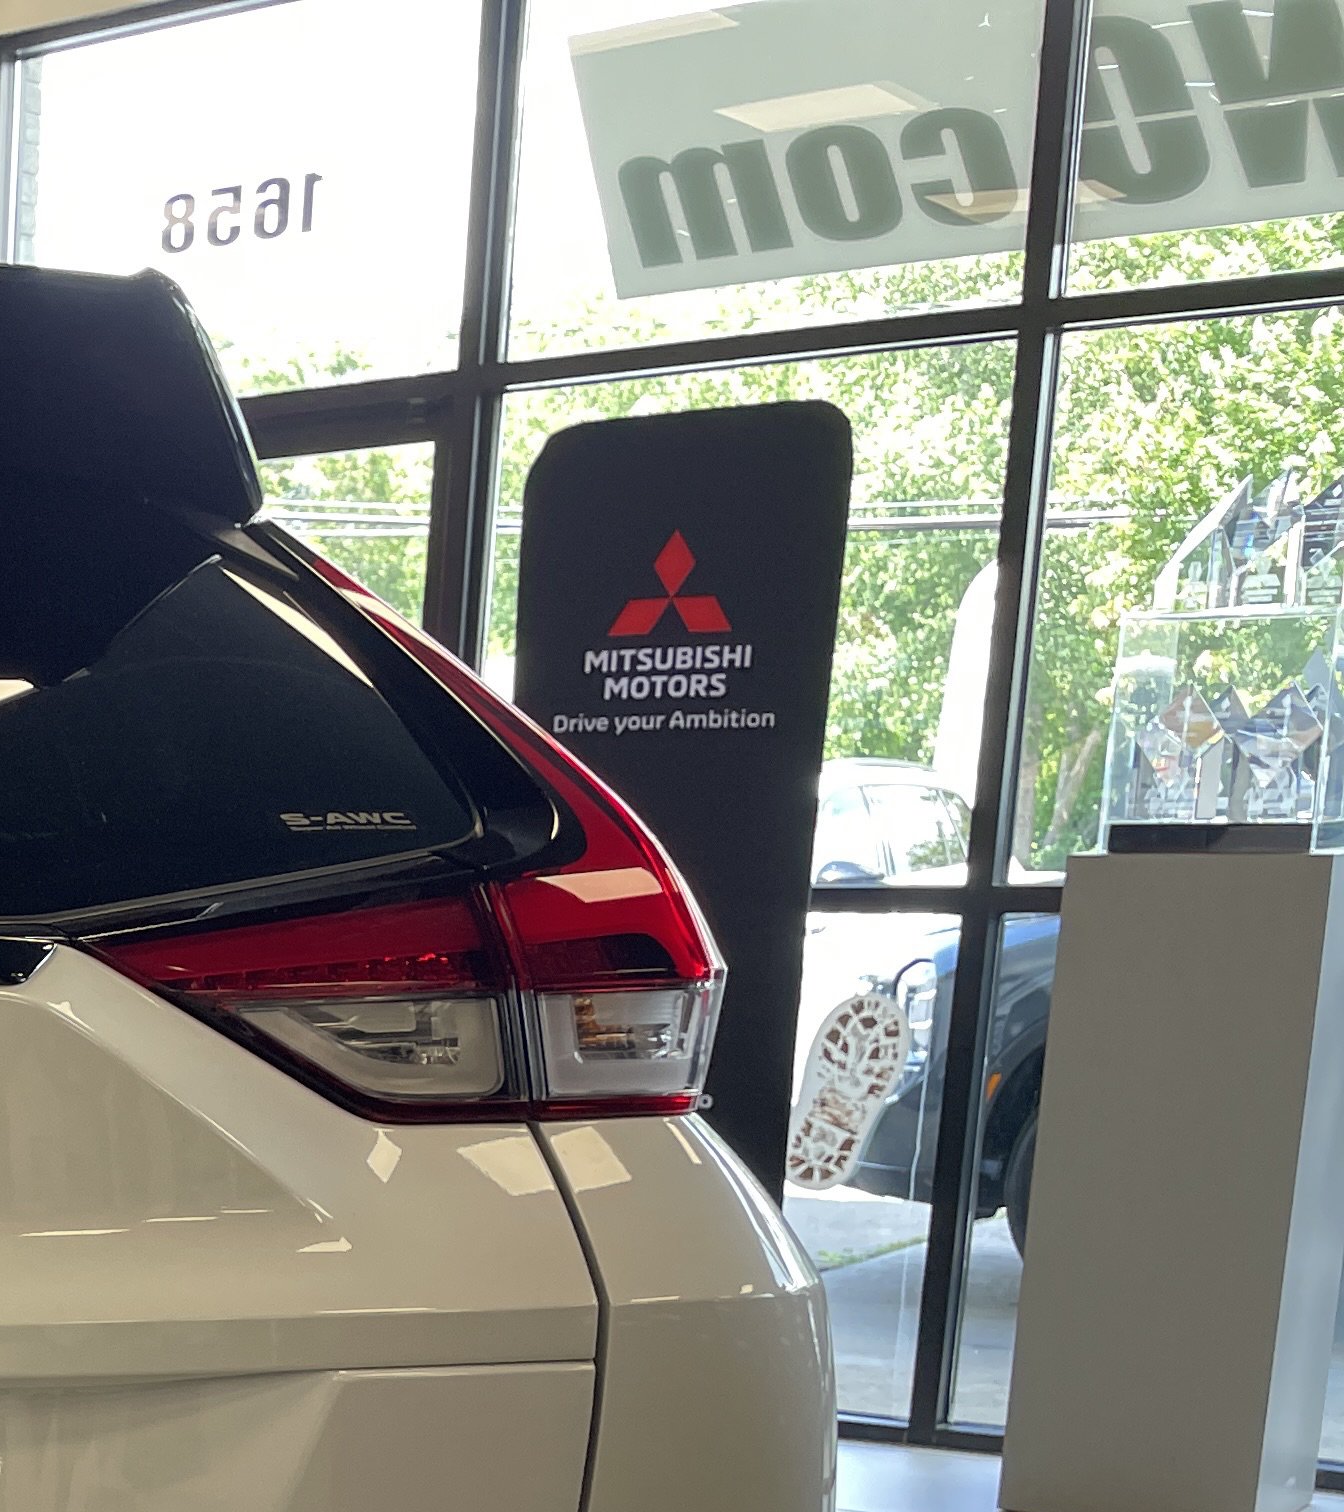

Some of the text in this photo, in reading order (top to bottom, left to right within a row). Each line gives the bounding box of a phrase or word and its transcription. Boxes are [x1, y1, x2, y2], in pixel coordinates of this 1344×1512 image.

[583, 645, 752, 673] MITSUBISHI
[603, 673, 727, 700] MOTORS
[552, 707, 775, 736] Drive your Ambition
[279, 811, 412, 826] S-AWC
